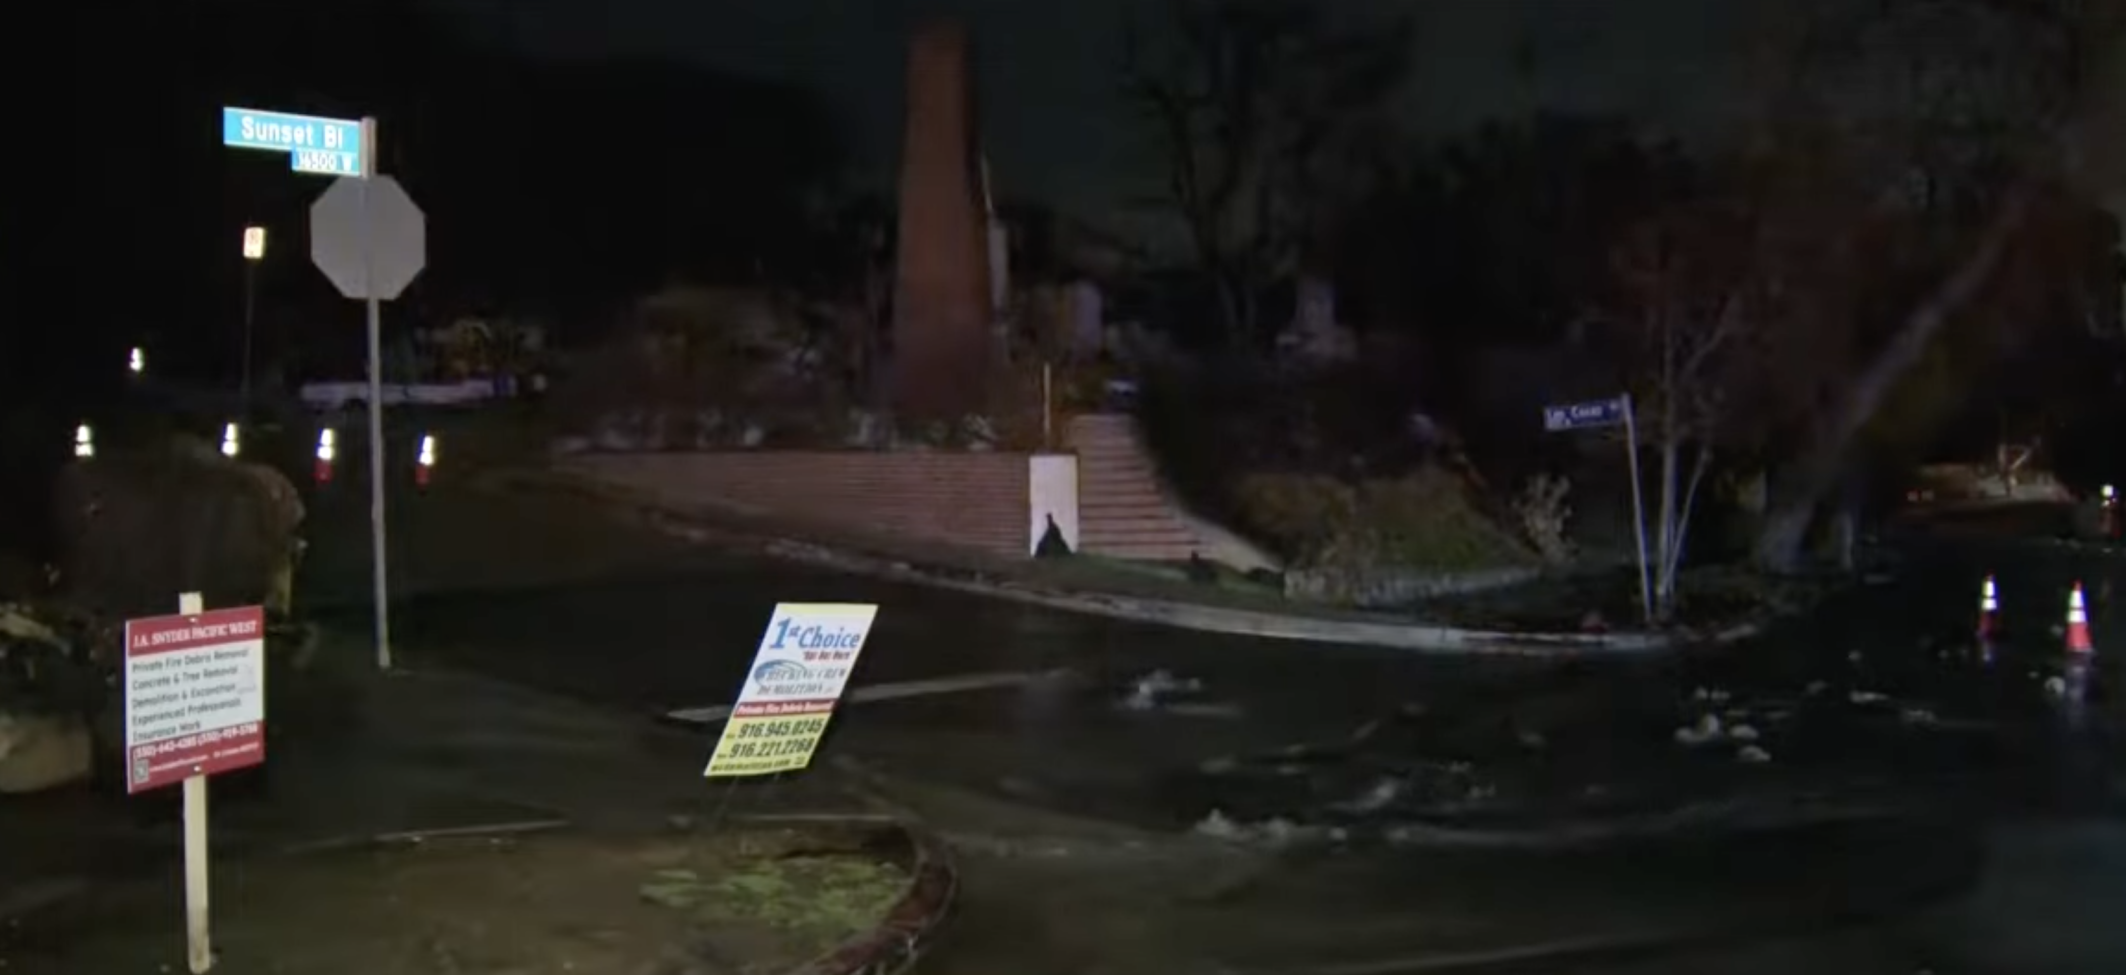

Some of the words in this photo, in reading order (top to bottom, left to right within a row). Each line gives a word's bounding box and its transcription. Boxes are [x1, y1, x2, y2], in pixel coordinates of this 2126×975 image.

[241, 116, 314, 146] Sunset
[323, 124, 343, 148] Bl
[151, 630, 191, 645] SNYDER
[192, 625, 227, 639] PACIFIC
[229, 620, 256, 634] WEST
[798, 625, 861, 648] Choice
[132, 660, 163, 673] Private
[165, 657, 182, 669] Fire
[184, 654, 211, 666] Debris
[214, 649, 248, 659] Removal
[132, 676, 171, 691] Concrete
[182, 670, 201, 681] Tree
[203, 667, 238, 679] Removal
[132, 693, 179, 708] Demolition
[132, 707, 186, 726] Experienced
[133, 726, 177, 741] Insurance
[180, 721, 200, 731] Work
